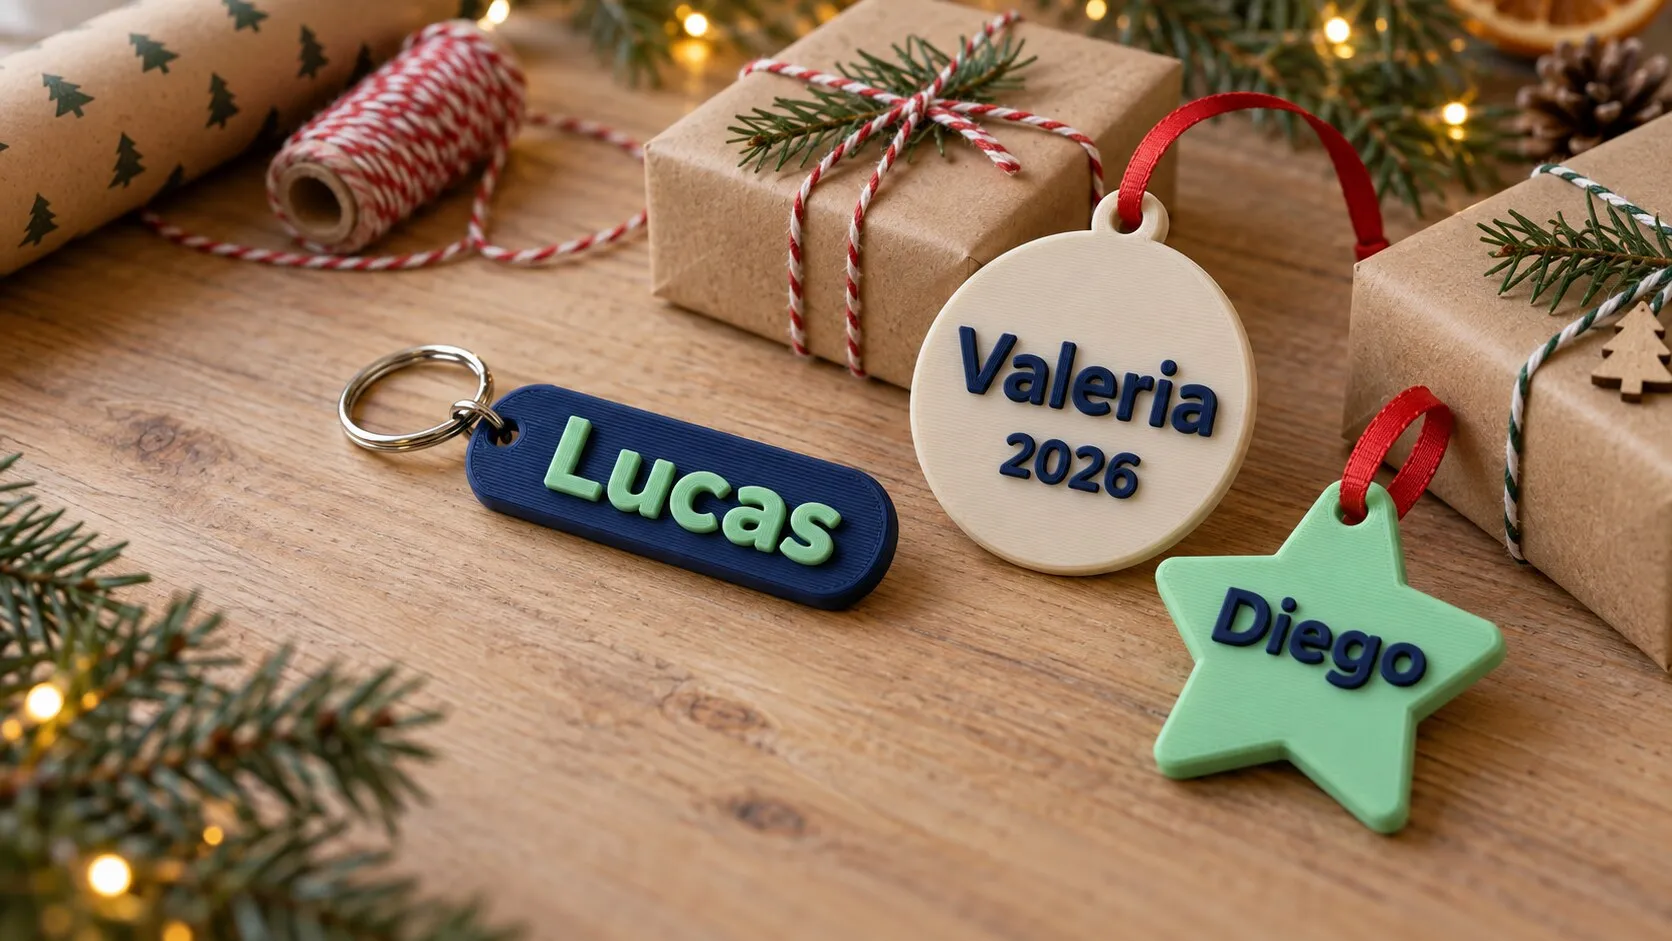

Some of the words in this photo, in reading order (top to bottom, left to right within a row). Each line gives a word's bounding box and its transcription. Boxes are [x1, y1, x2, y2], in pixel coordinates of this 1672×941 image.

[958, 325, 1219, 437] Valeria
[543, 415, 841, 565] Lucas
[999, 433, 1141, 499] 2026
[1211, 586, 1428, 690] Diego
